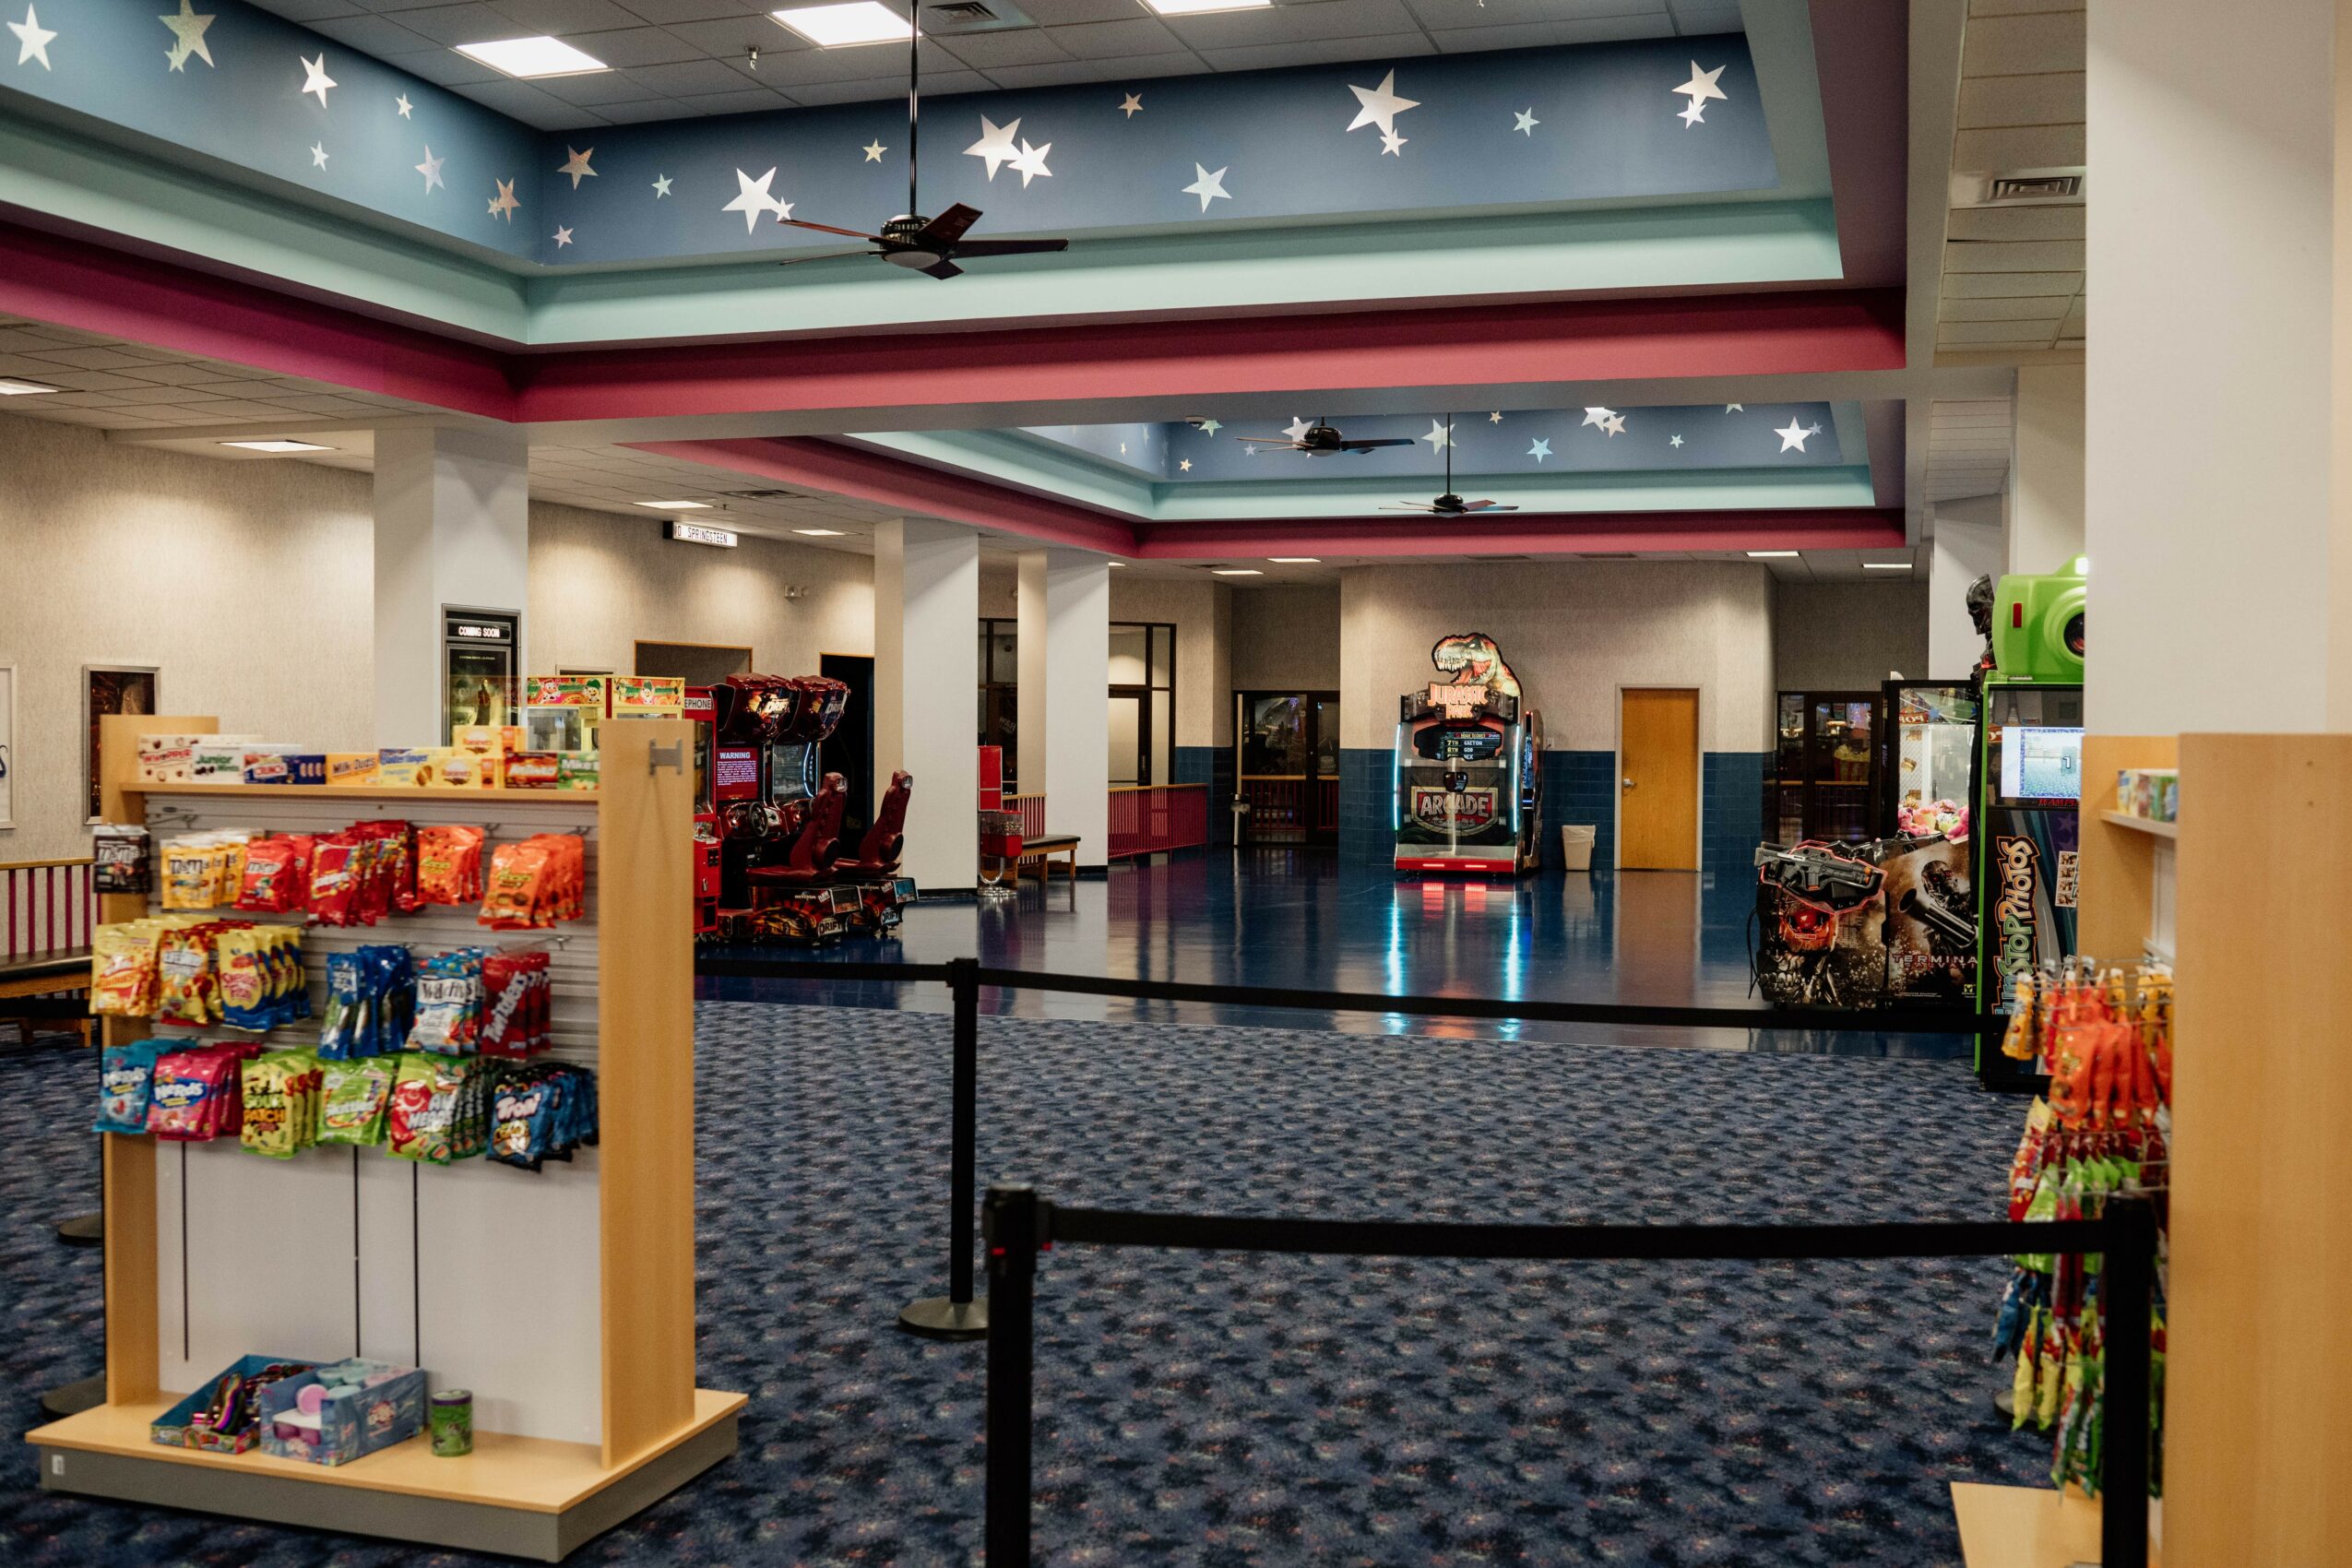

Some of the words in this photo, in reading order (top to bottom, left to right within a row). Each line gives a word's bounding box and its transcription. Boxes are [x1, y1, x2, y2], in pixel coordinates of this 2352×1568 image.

[687, 527, 728, 544] SPRINGSTEEN
[458, 626, 481, 636] COMING
[482, 627, 500, 637] SOON
[1428, 683, 1488, 707] JURASSIC
[1445, 704, 1473, 719] PARK
[196, 754, 233, 766] Junior
[2061, 755, 2072, 769] 1
[331, 762, 350, 776] Milk
[1420, 793, 1490, 818] ARCADE
[818, 921, 842, 935] DRIFT
[1893, 954, 1978, 963] TERMINA
[243, 1109, 286, 1124] PATCH
